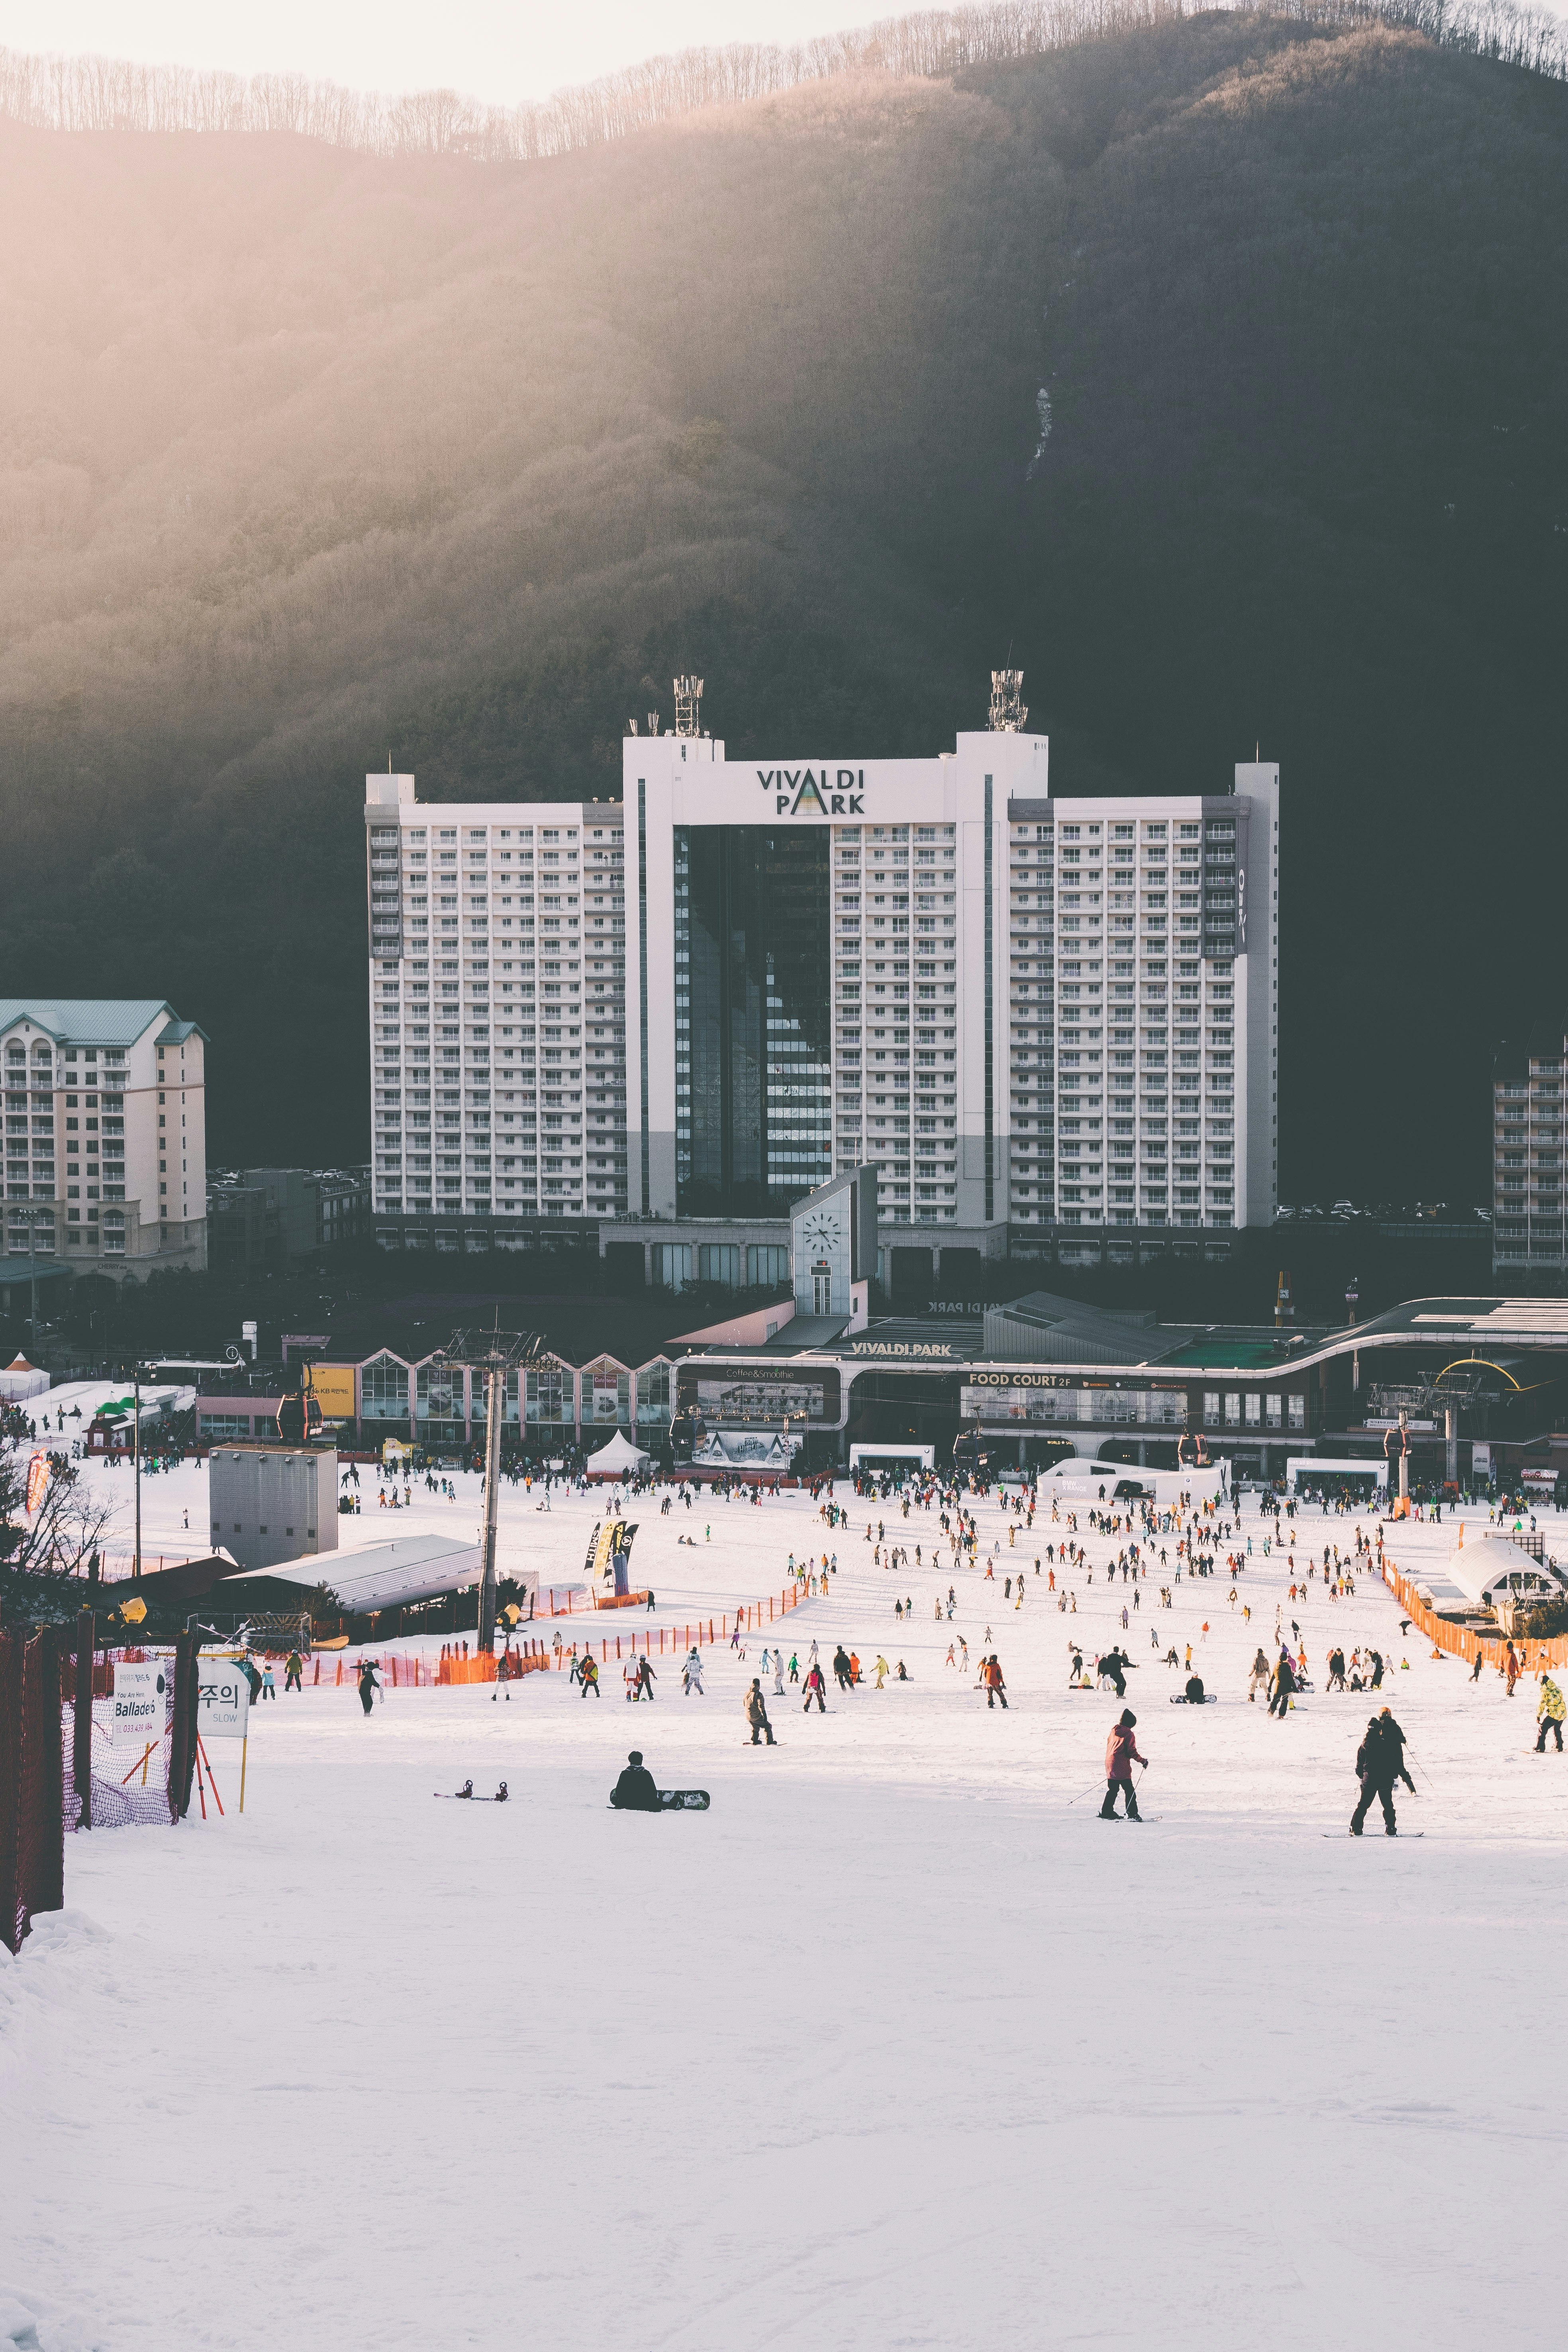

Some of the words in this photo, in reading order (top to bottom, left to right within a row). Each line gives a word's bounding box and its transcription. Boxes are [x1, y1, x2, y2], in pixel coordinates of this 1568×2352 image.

[757, 768, 864, 793] VIVALDI
[776, 790, 865, 815] PARK
[852, 1343, 909, 1355] VIVALDI
[913, 1344, 952, 1356] PARK
[727, 1369, 794, 1379] Coffee&Smoothie
[970, 1374, 1009, 1385] FOOD
[1013, 1375, 1057, 1386] COURT
[586, 1530, 600, 1561] SMITH
[200, 1684, 238, 1709] 주의
[116, 1701, 149, 1716] Ballade
[213, 1714, 237, 1723] SLOW
